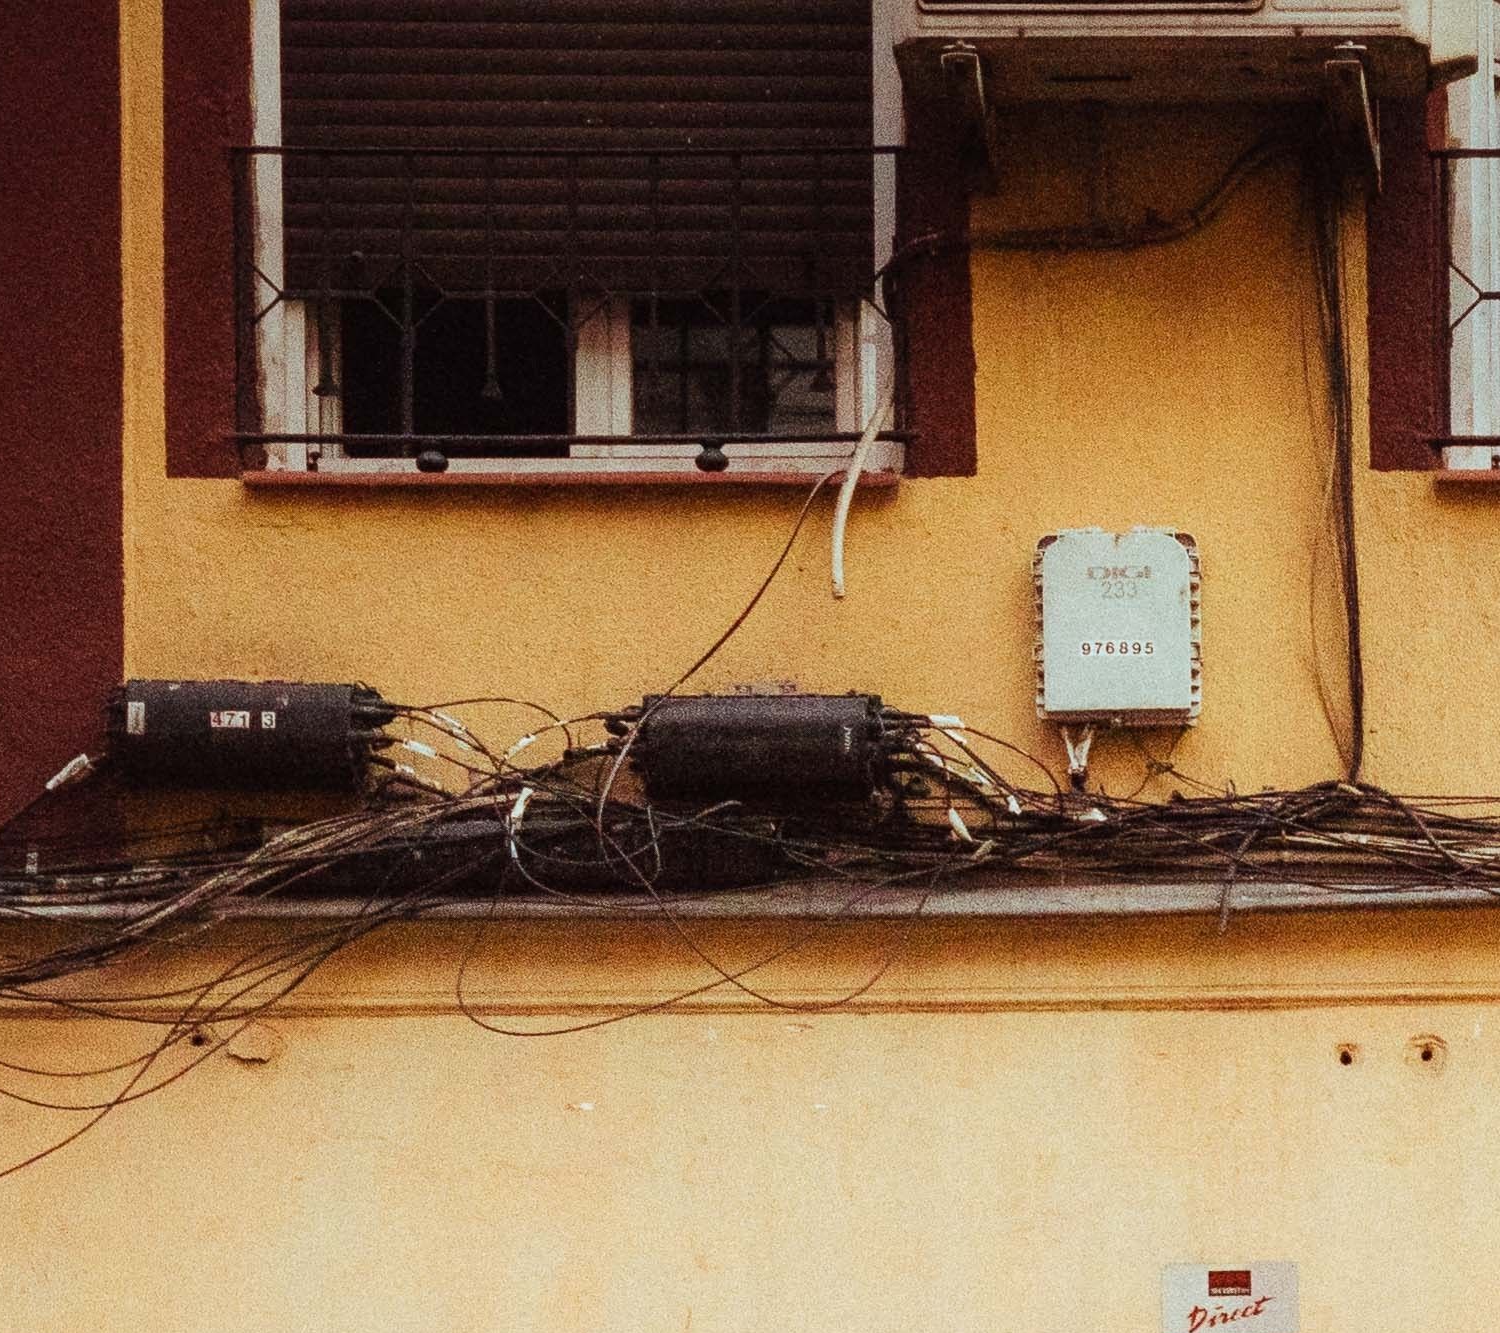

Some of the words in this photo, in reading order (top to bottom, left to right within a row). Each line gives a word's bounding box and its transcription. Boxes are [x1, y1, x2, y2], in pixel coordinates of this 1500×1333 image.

[1102, 581, 1138, 599] 233
[1081, 642, 1154, 655] 976895
[263, 712, 275, 727] 3
[1187, 1295, 1274, 1333] Direct
